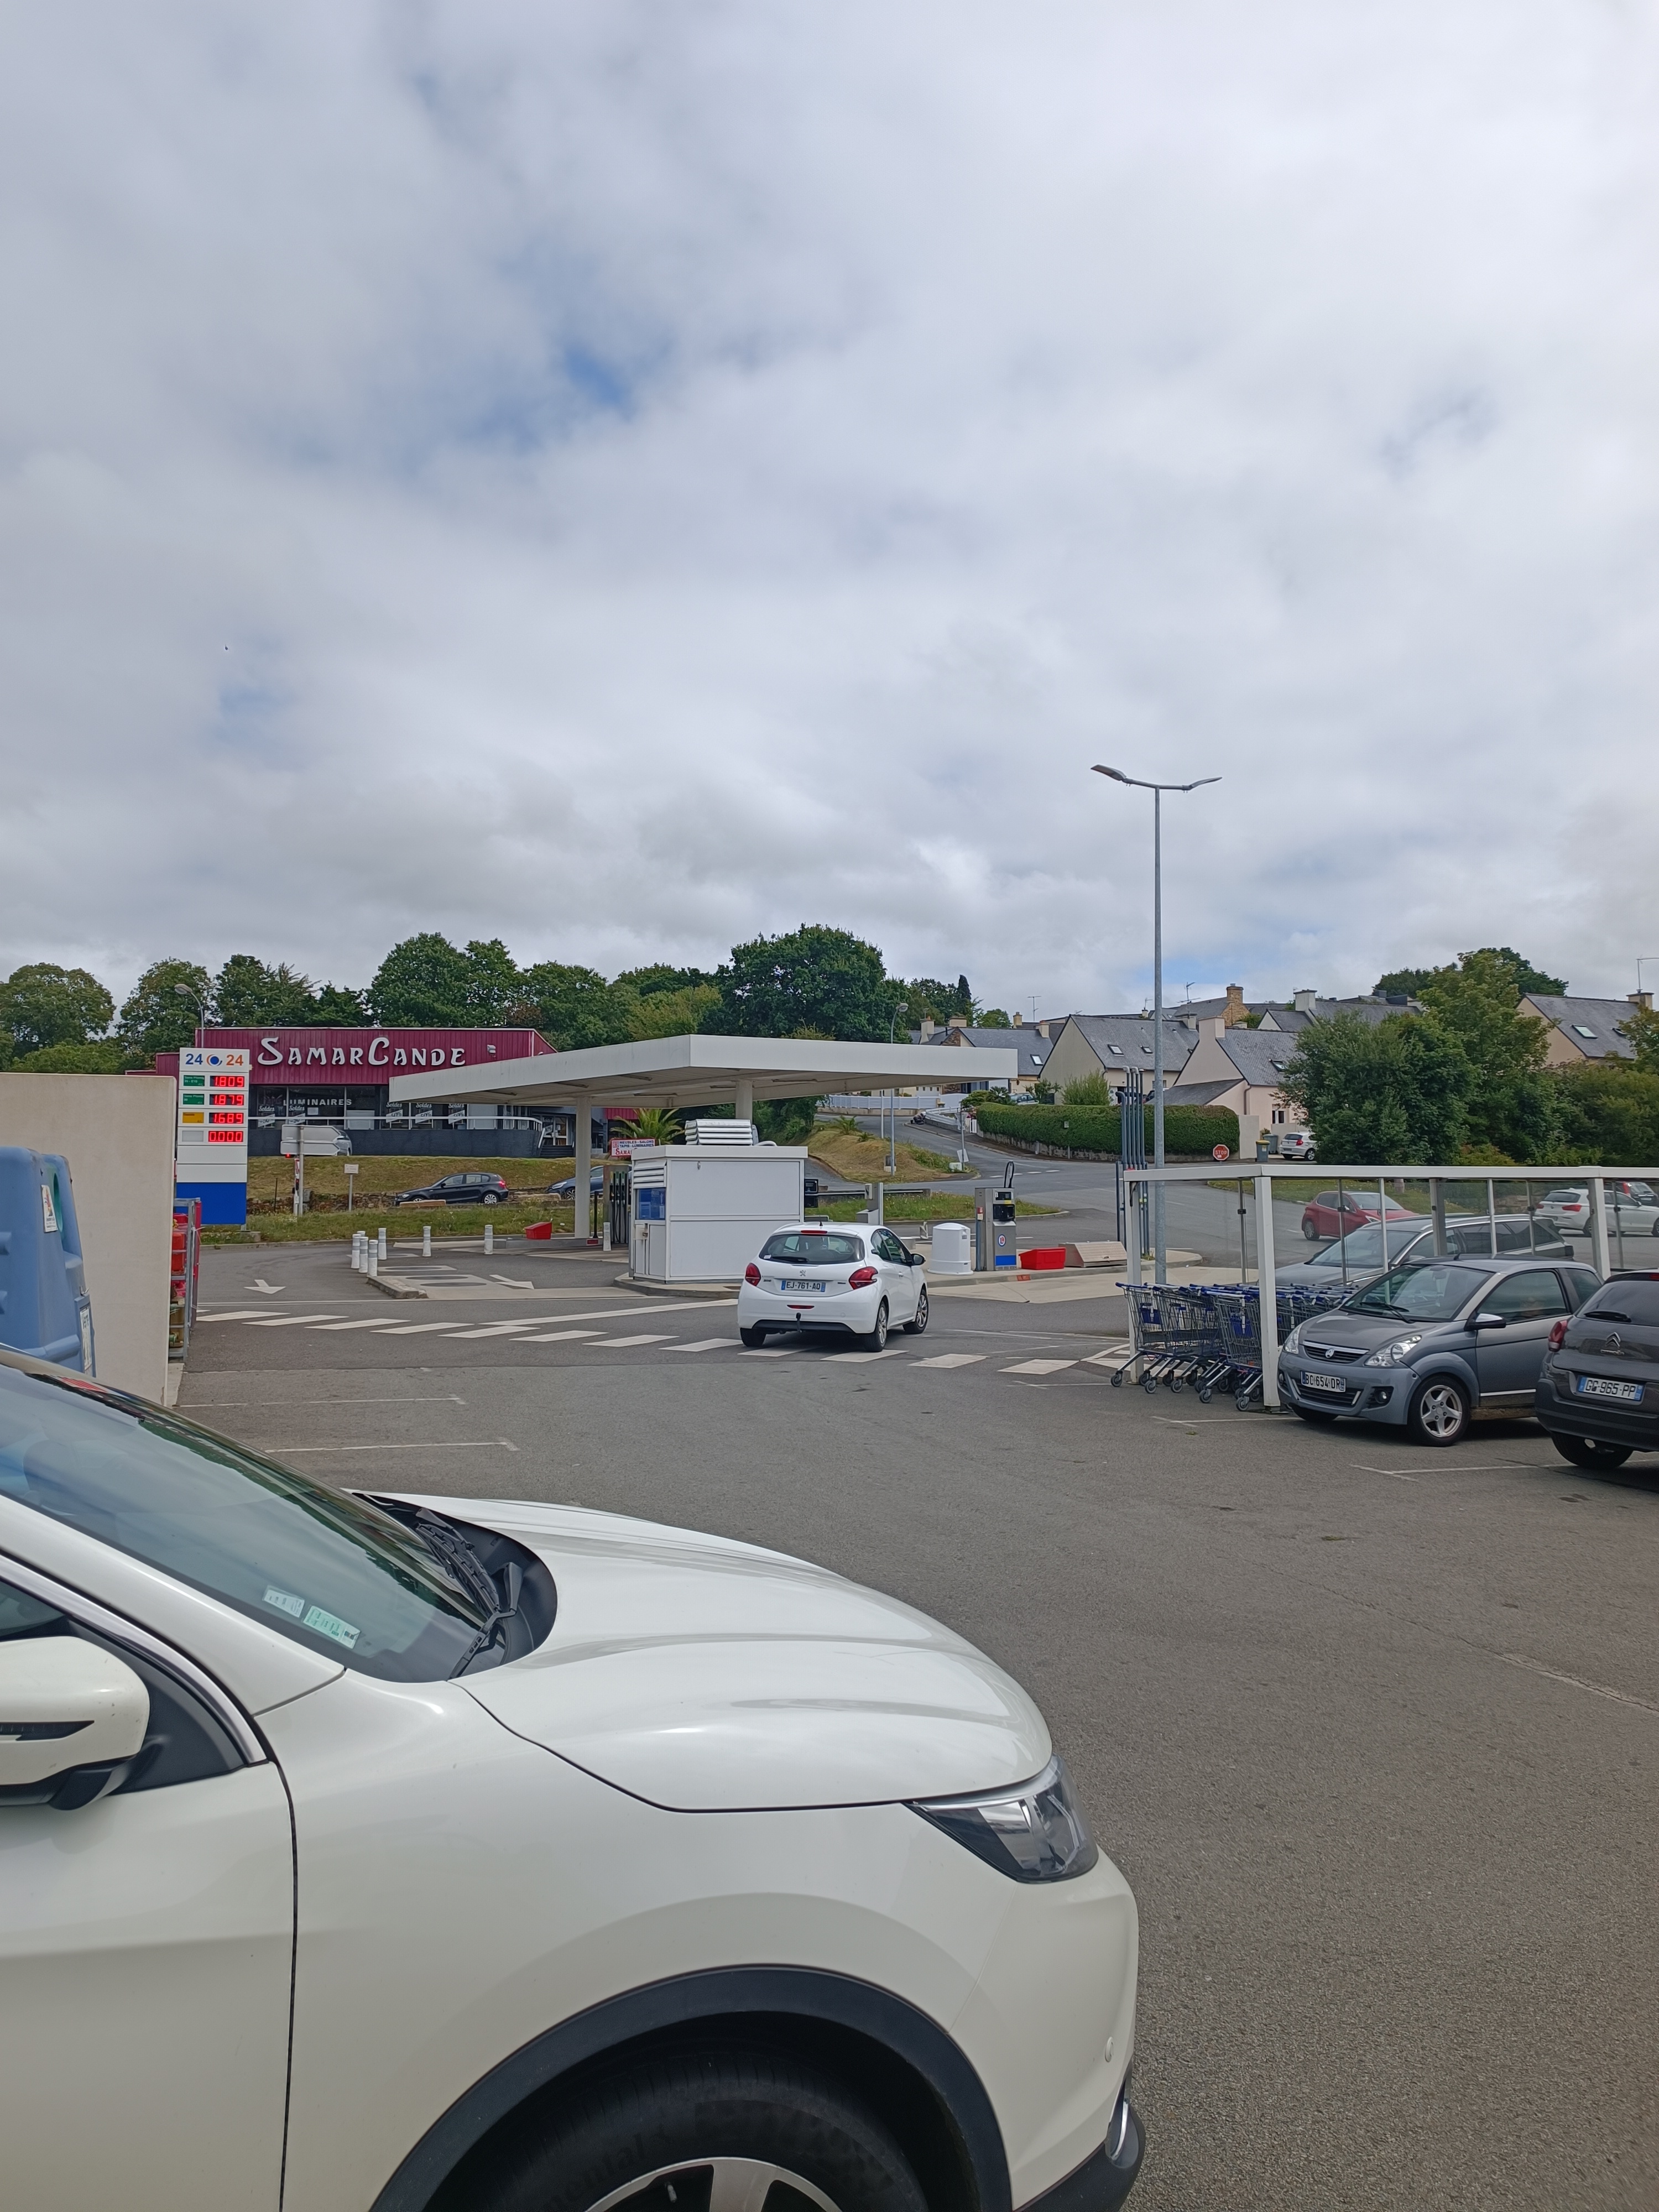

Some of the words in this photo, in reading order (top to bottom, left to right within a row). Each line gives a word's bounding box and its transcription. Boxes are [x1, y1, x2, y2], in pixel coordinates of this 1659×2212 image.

[185, 1053, 203, 1065] 24
[226, 1055, 243, 1066] 24
[215, 1077, 244, 1087] 1.809
[214, 1095, 243, 1105] 1.879
[213, 1113, 243, 1123] 1.689
[208, 1131, 243, 1142] 0.000
